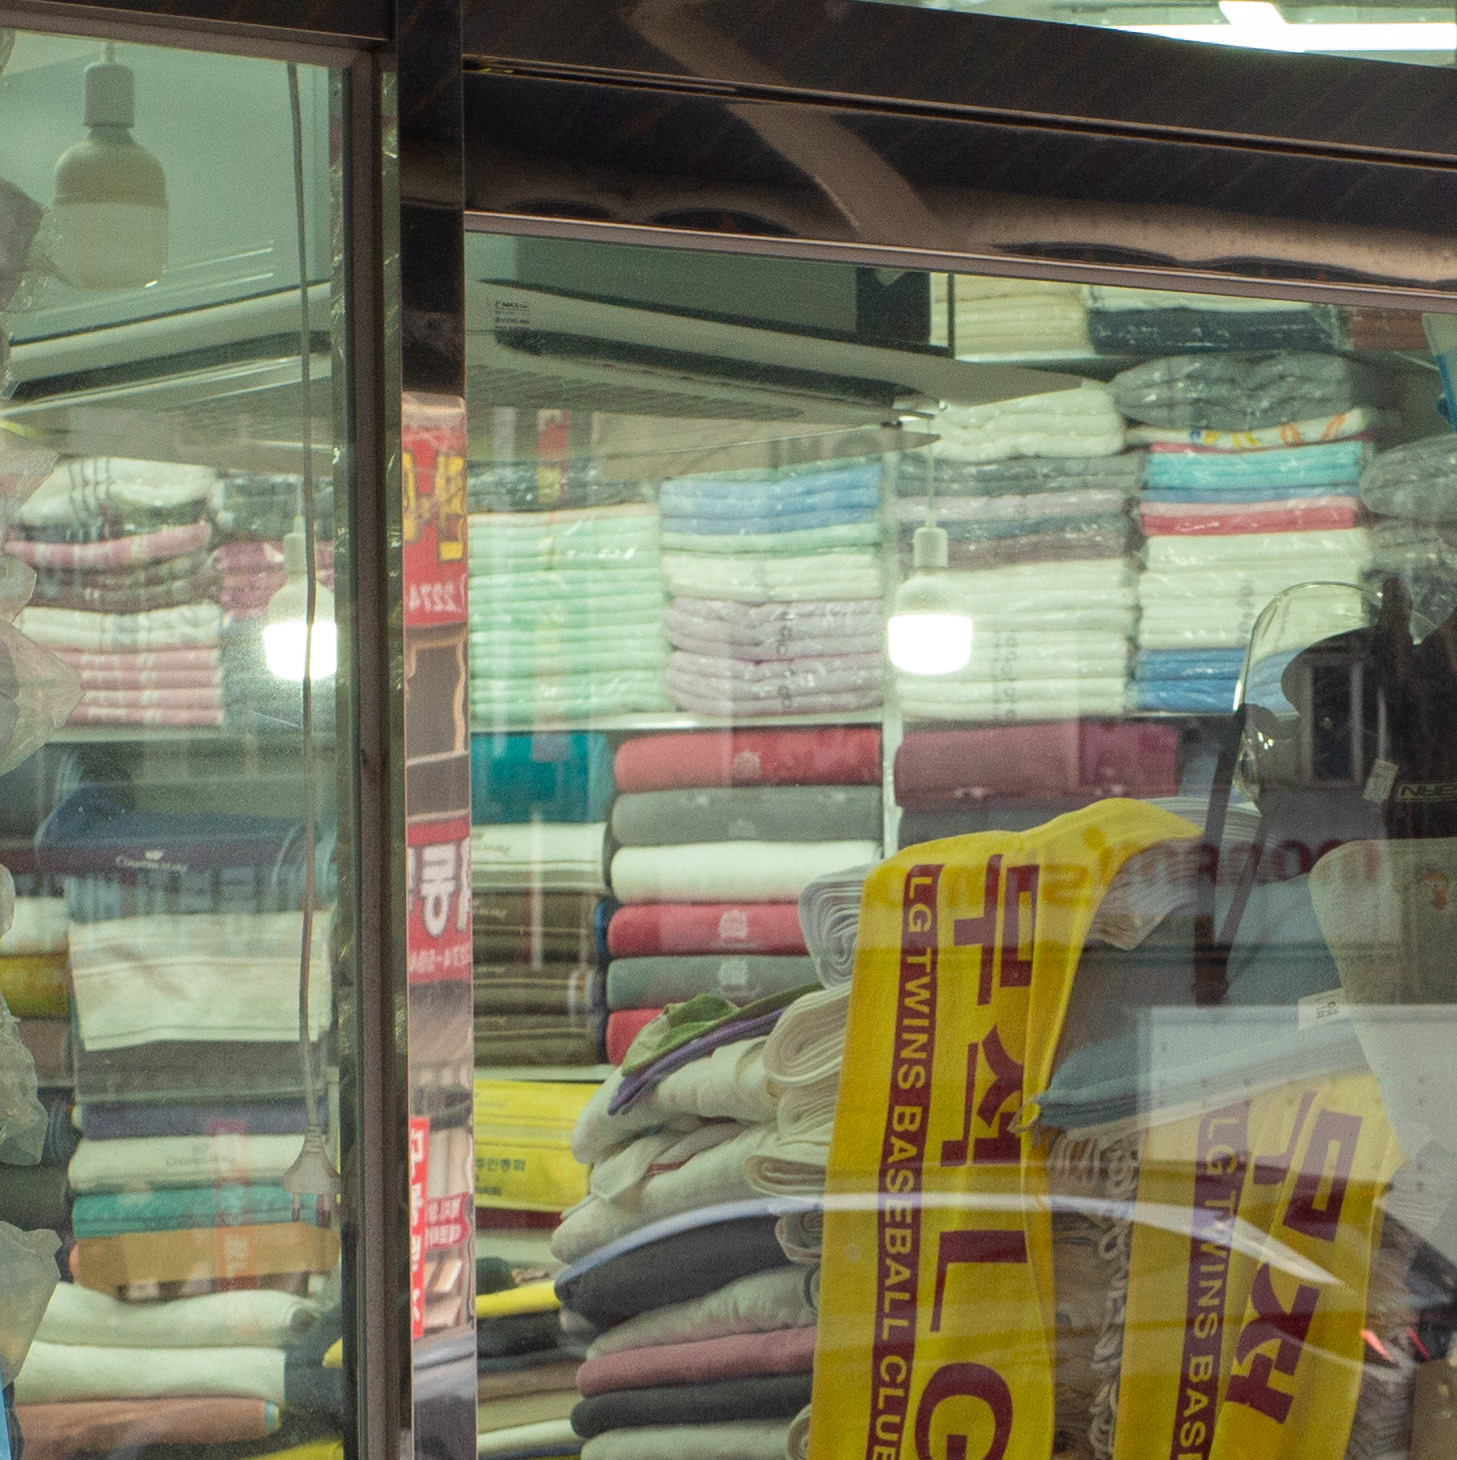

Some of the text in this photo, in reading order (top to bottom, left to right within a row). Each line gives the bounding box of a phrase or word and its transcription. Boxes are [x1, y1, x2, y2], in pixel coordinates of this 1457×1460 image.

[906, 874, 935, 932] LG
[895, 948, 933, 1091] TWINS
[939, 854, 1039, 1167] 무적
[1204, 1115, 1240, 1177] LG
[880, 1103, 922, 1340] BASEBALL
[1189, 1188, 1238, 1340] TWINS
